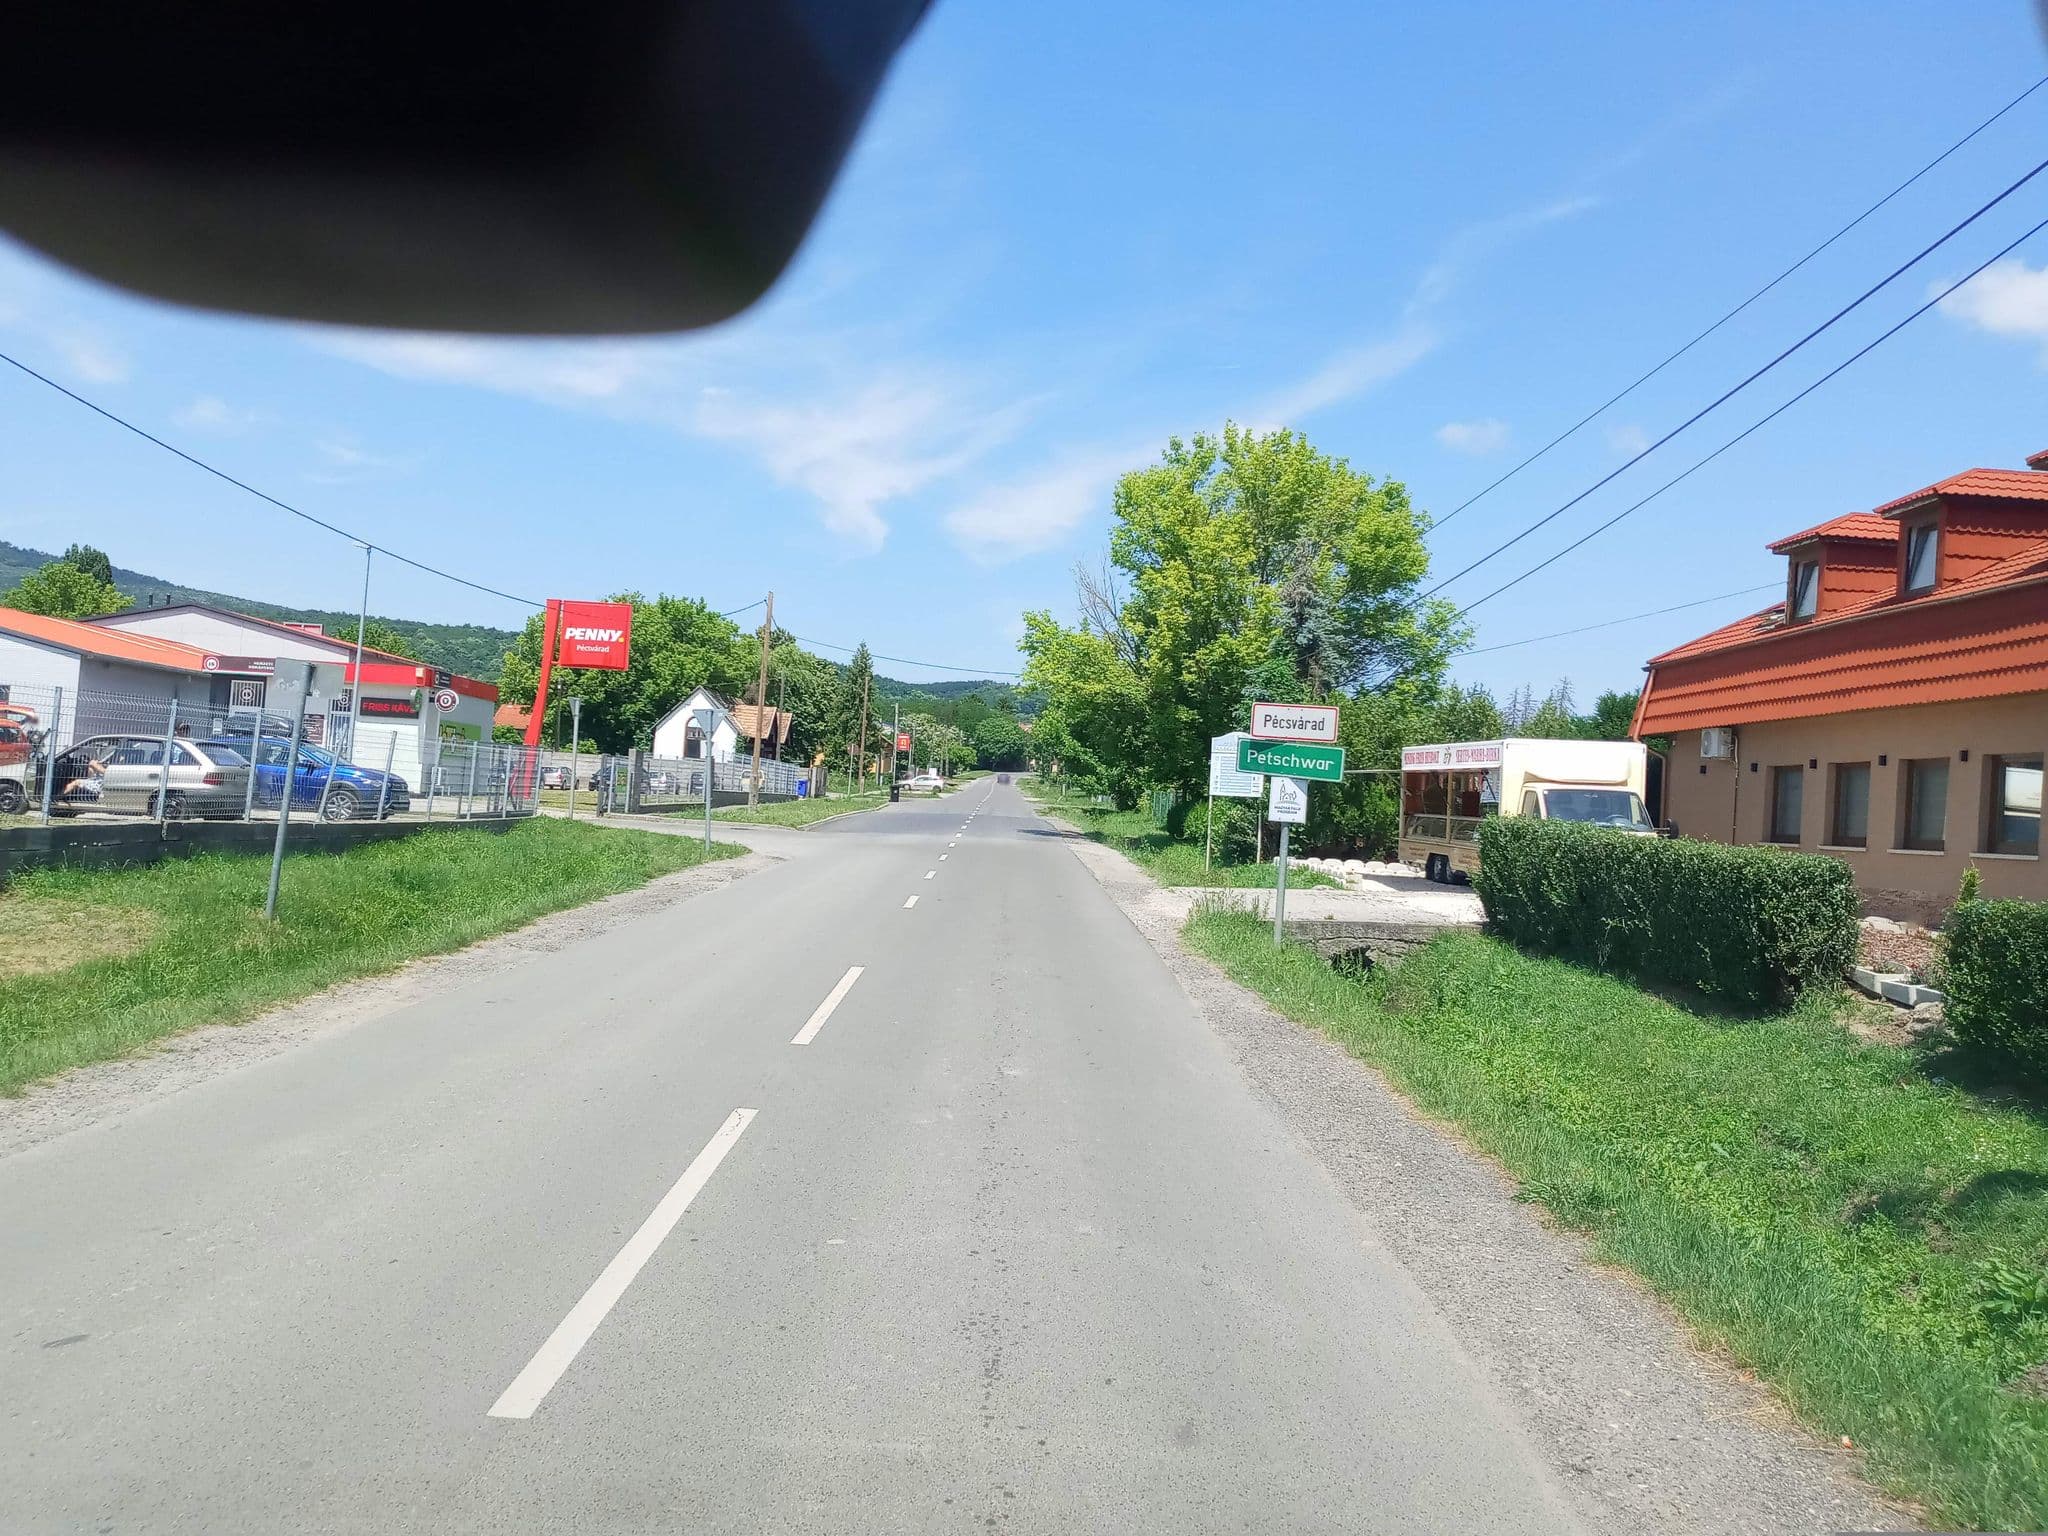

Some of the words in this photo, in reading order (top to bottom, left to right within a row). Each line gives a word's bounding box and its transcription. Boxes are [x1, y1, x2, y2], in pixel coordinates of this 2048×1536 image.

[576, 644, 610, 653] Pécsvárad
[1263, 714, 1325, 731] Pécsvárad
[1247, 749, 1335, 771] Petschwar
